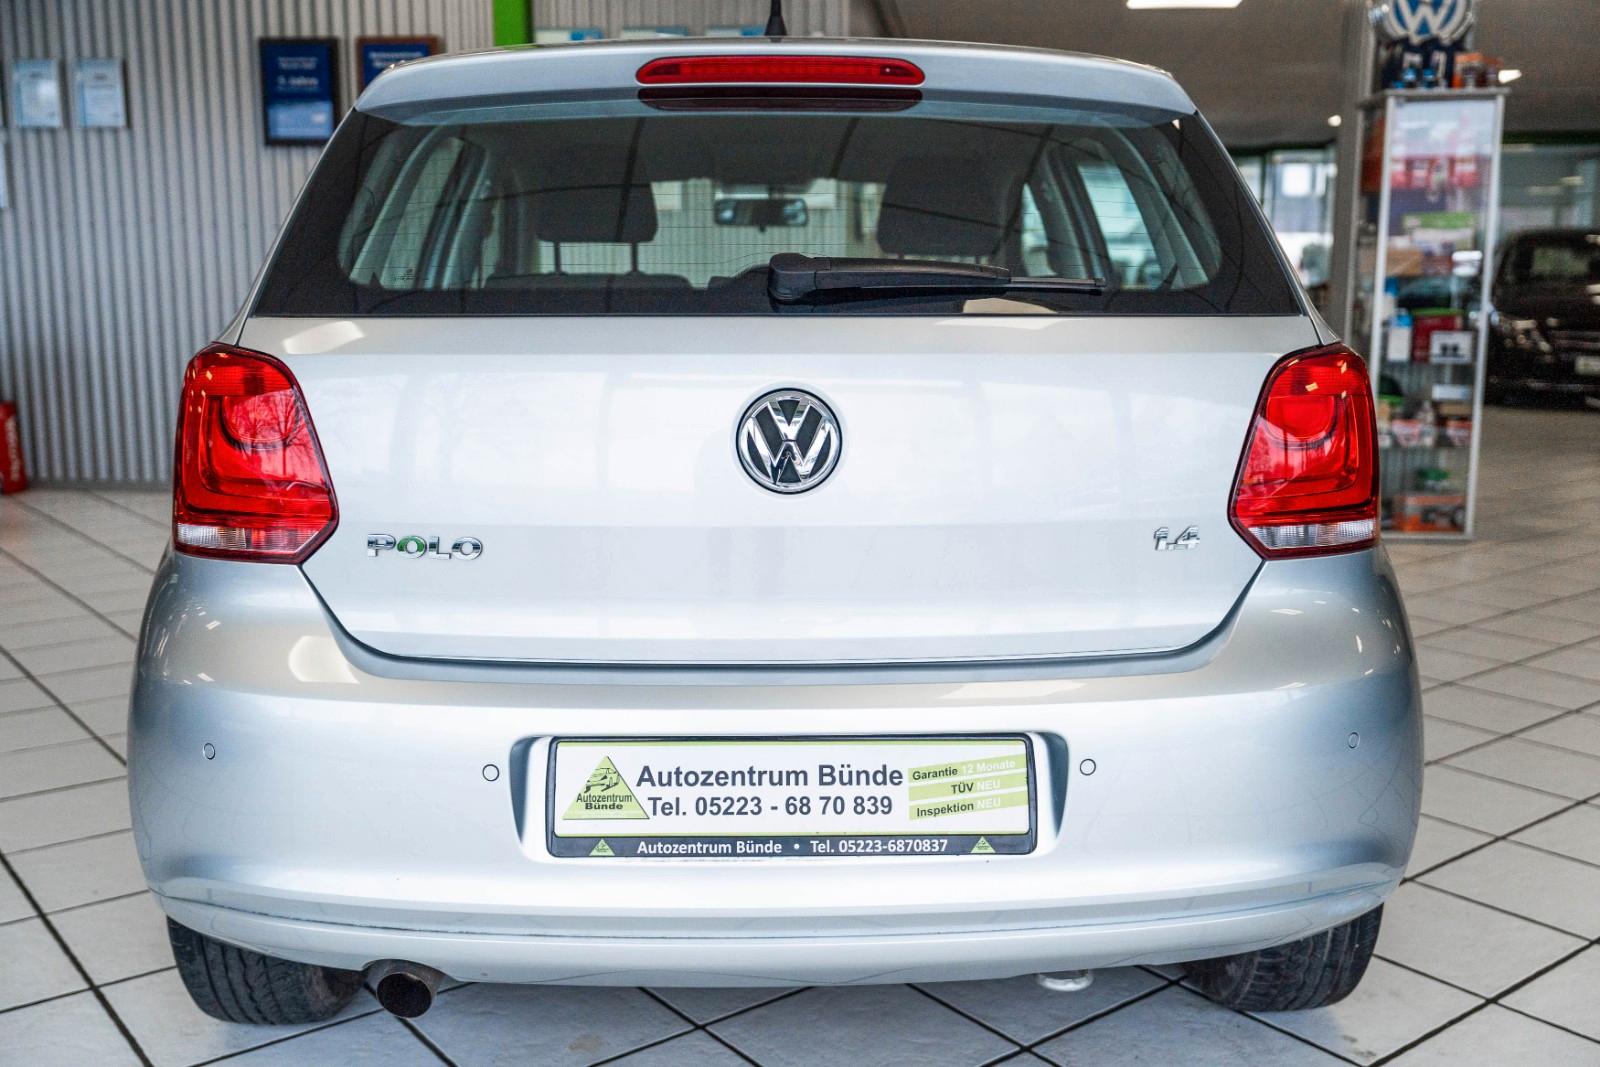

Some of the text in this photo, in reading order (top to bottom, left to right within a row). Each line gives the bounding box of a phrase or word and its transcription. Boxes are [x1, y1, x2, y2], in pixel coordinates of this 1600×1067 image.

[367, 533, 484, 560] POLO
[1154, 525, 1200, 551] 1.4
[636, 764, 903, 787] Autozentrum Bünde
[912, 760, 1016, 781] Garantie 12 Monate
[576, 793, 632, 803] Autozentrum
[951, 780, 1001, 795] TÜV NEU
[647, 797, 686, 816] Tel.
[695, 796, 763, 816] 05223
[785, 796, 811, 816] 68
[819, 796, 845, 815] 70
[853, 795, 893, 815] 839
[917, 797, 1001, 818] Inspektion NEU
[637, 839, 948, 854] Autozentrum Bünde Tel. 05223-6870837
